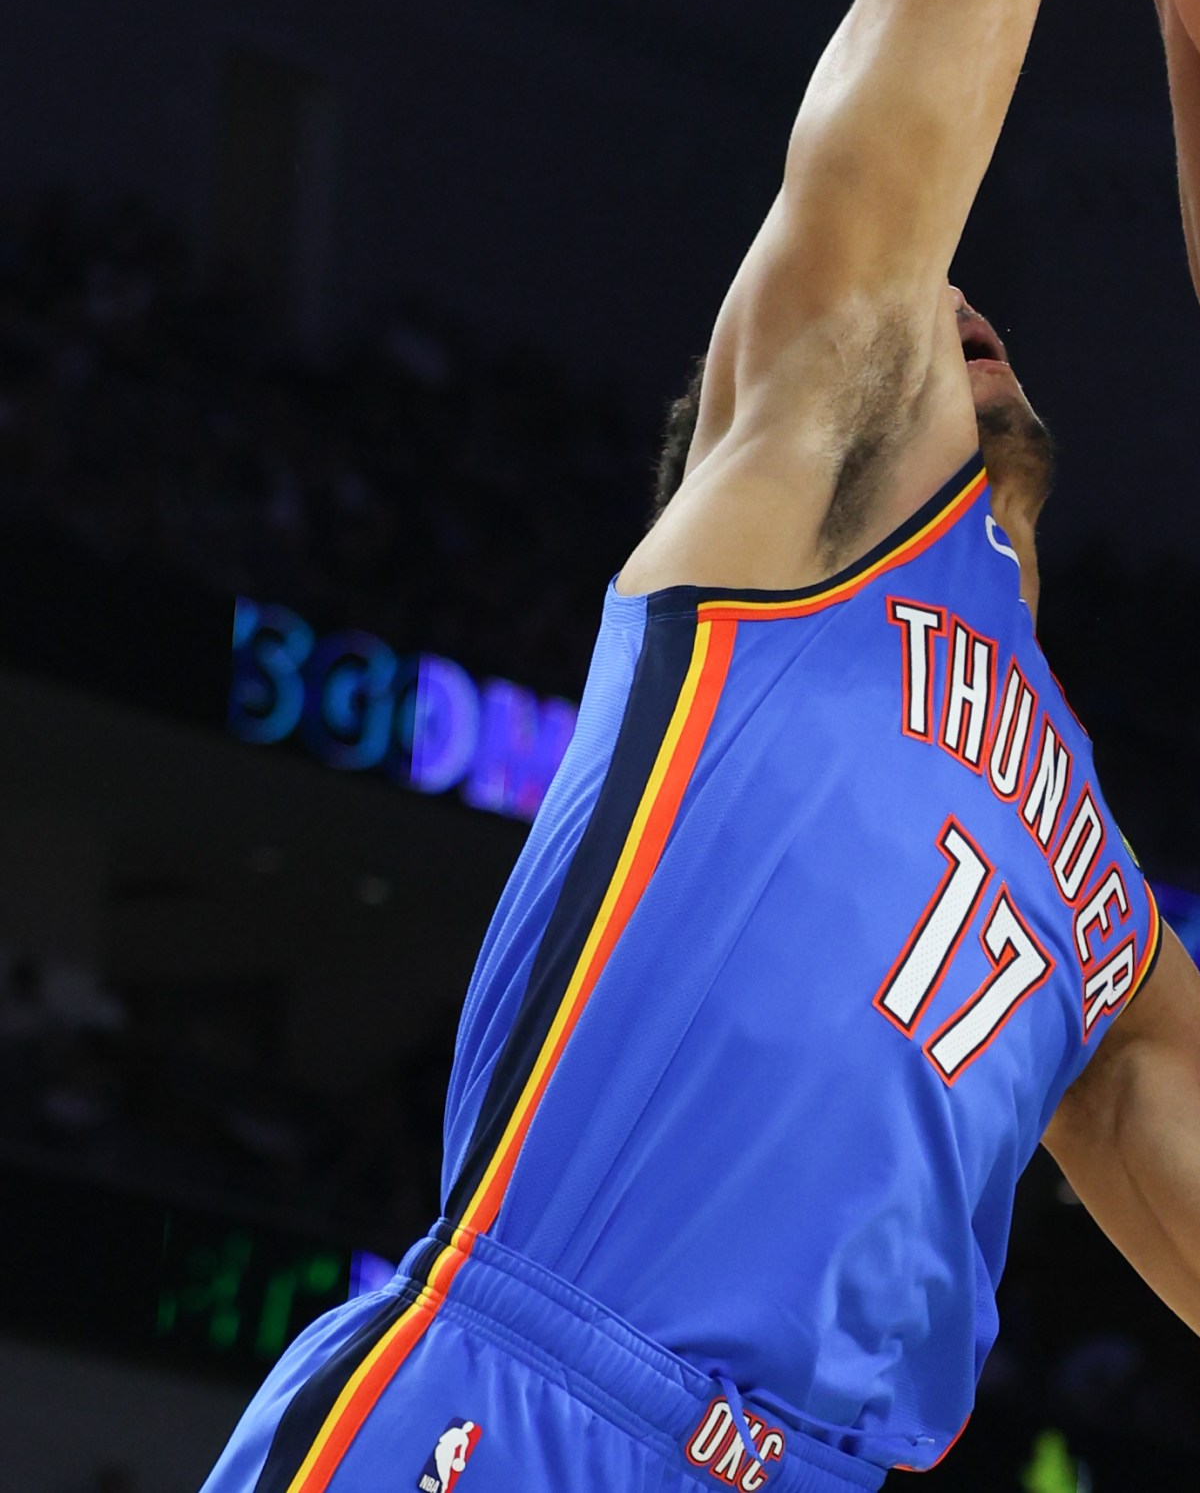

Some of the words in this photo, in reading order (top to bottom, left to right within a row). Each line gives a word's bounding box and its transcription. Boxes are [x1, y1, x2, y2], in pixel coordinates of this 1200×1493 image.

[872, 813, 1056, 1088] 17
[885, 595, 1137, 1044] THUNDER
[418, 1472, 441, 1493] NBA
